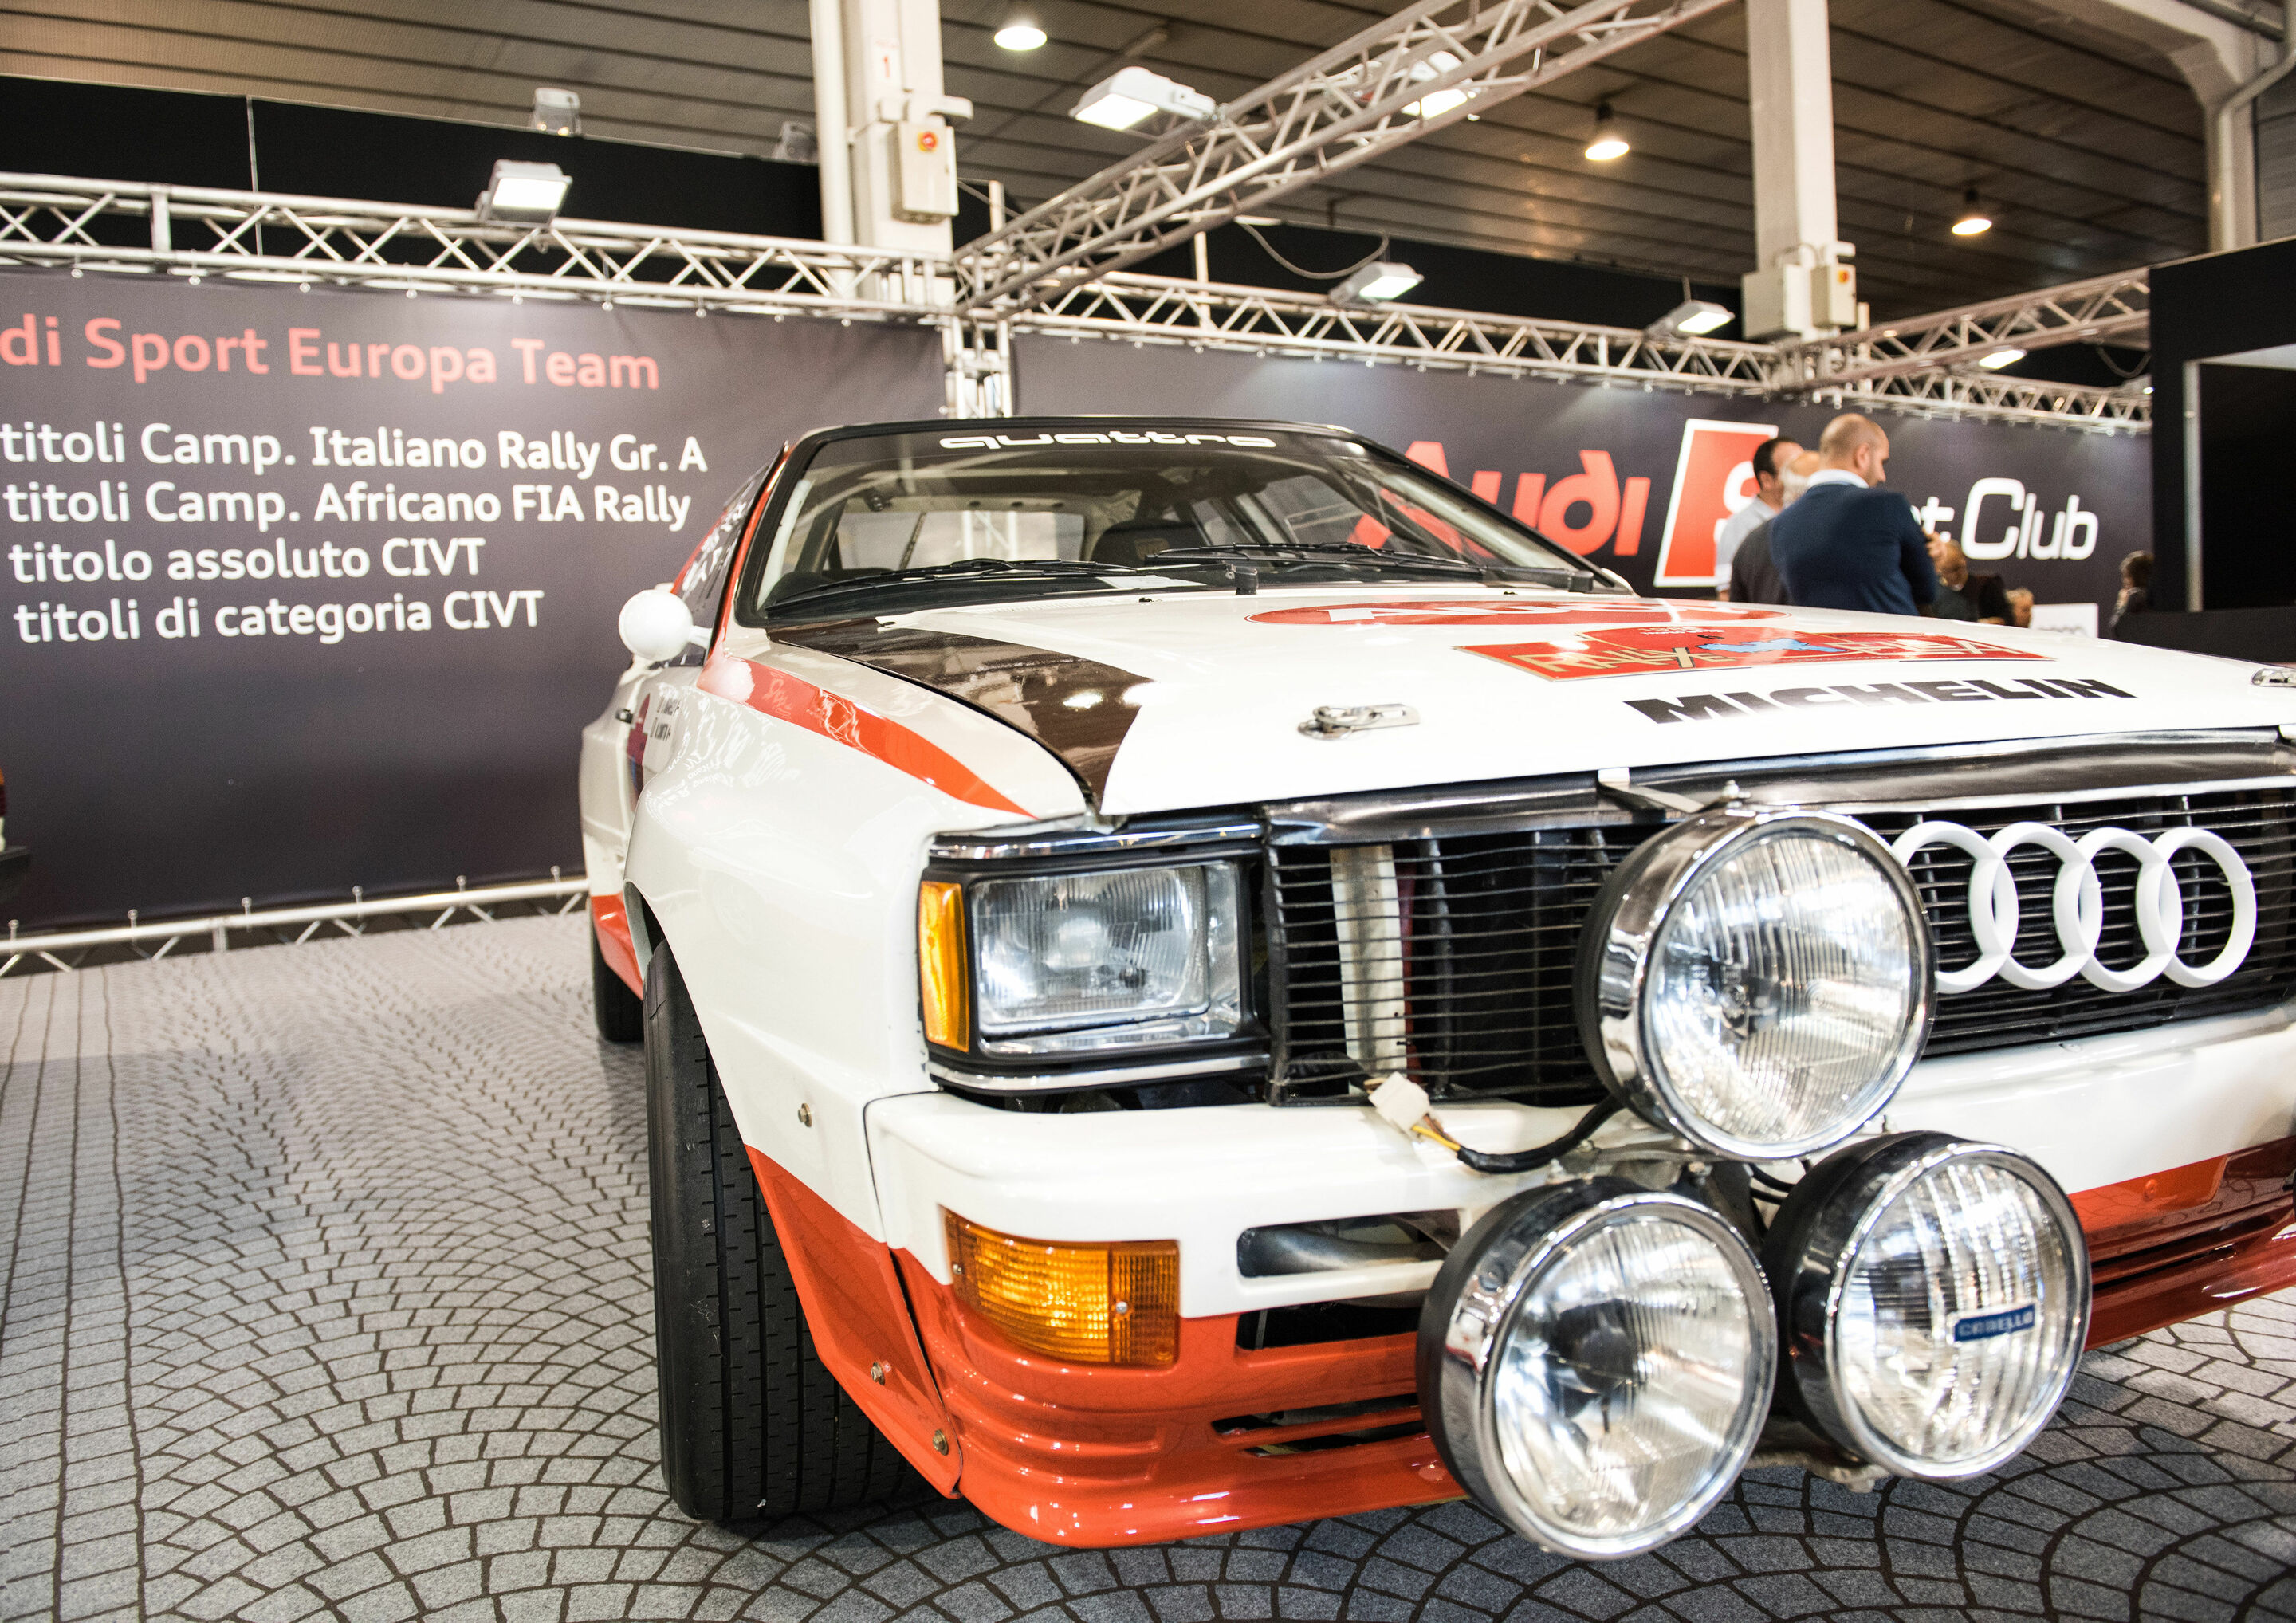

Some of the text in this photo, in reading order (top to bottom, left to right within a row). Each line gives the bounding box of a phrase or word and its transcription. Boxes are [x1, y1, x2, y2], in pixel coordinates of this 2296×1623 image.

[0, 312, 661, 395] di Sport Europa Team
[0, 420, 709, 480] titoli Camp. Italiano Rally Gr. A
[938, 430, 1276, 450] quattro
[2, 479, 692, 533] titoli Camp. Africano FIA Rally
[1961, 477, 2100, 560] Club
[7, 536, 486, 584] titolo assoluto CIVT
[13, 589, 545, 645] titoli di categoria CIVT
[1623, 678, 2138, 725] MICHELIN
